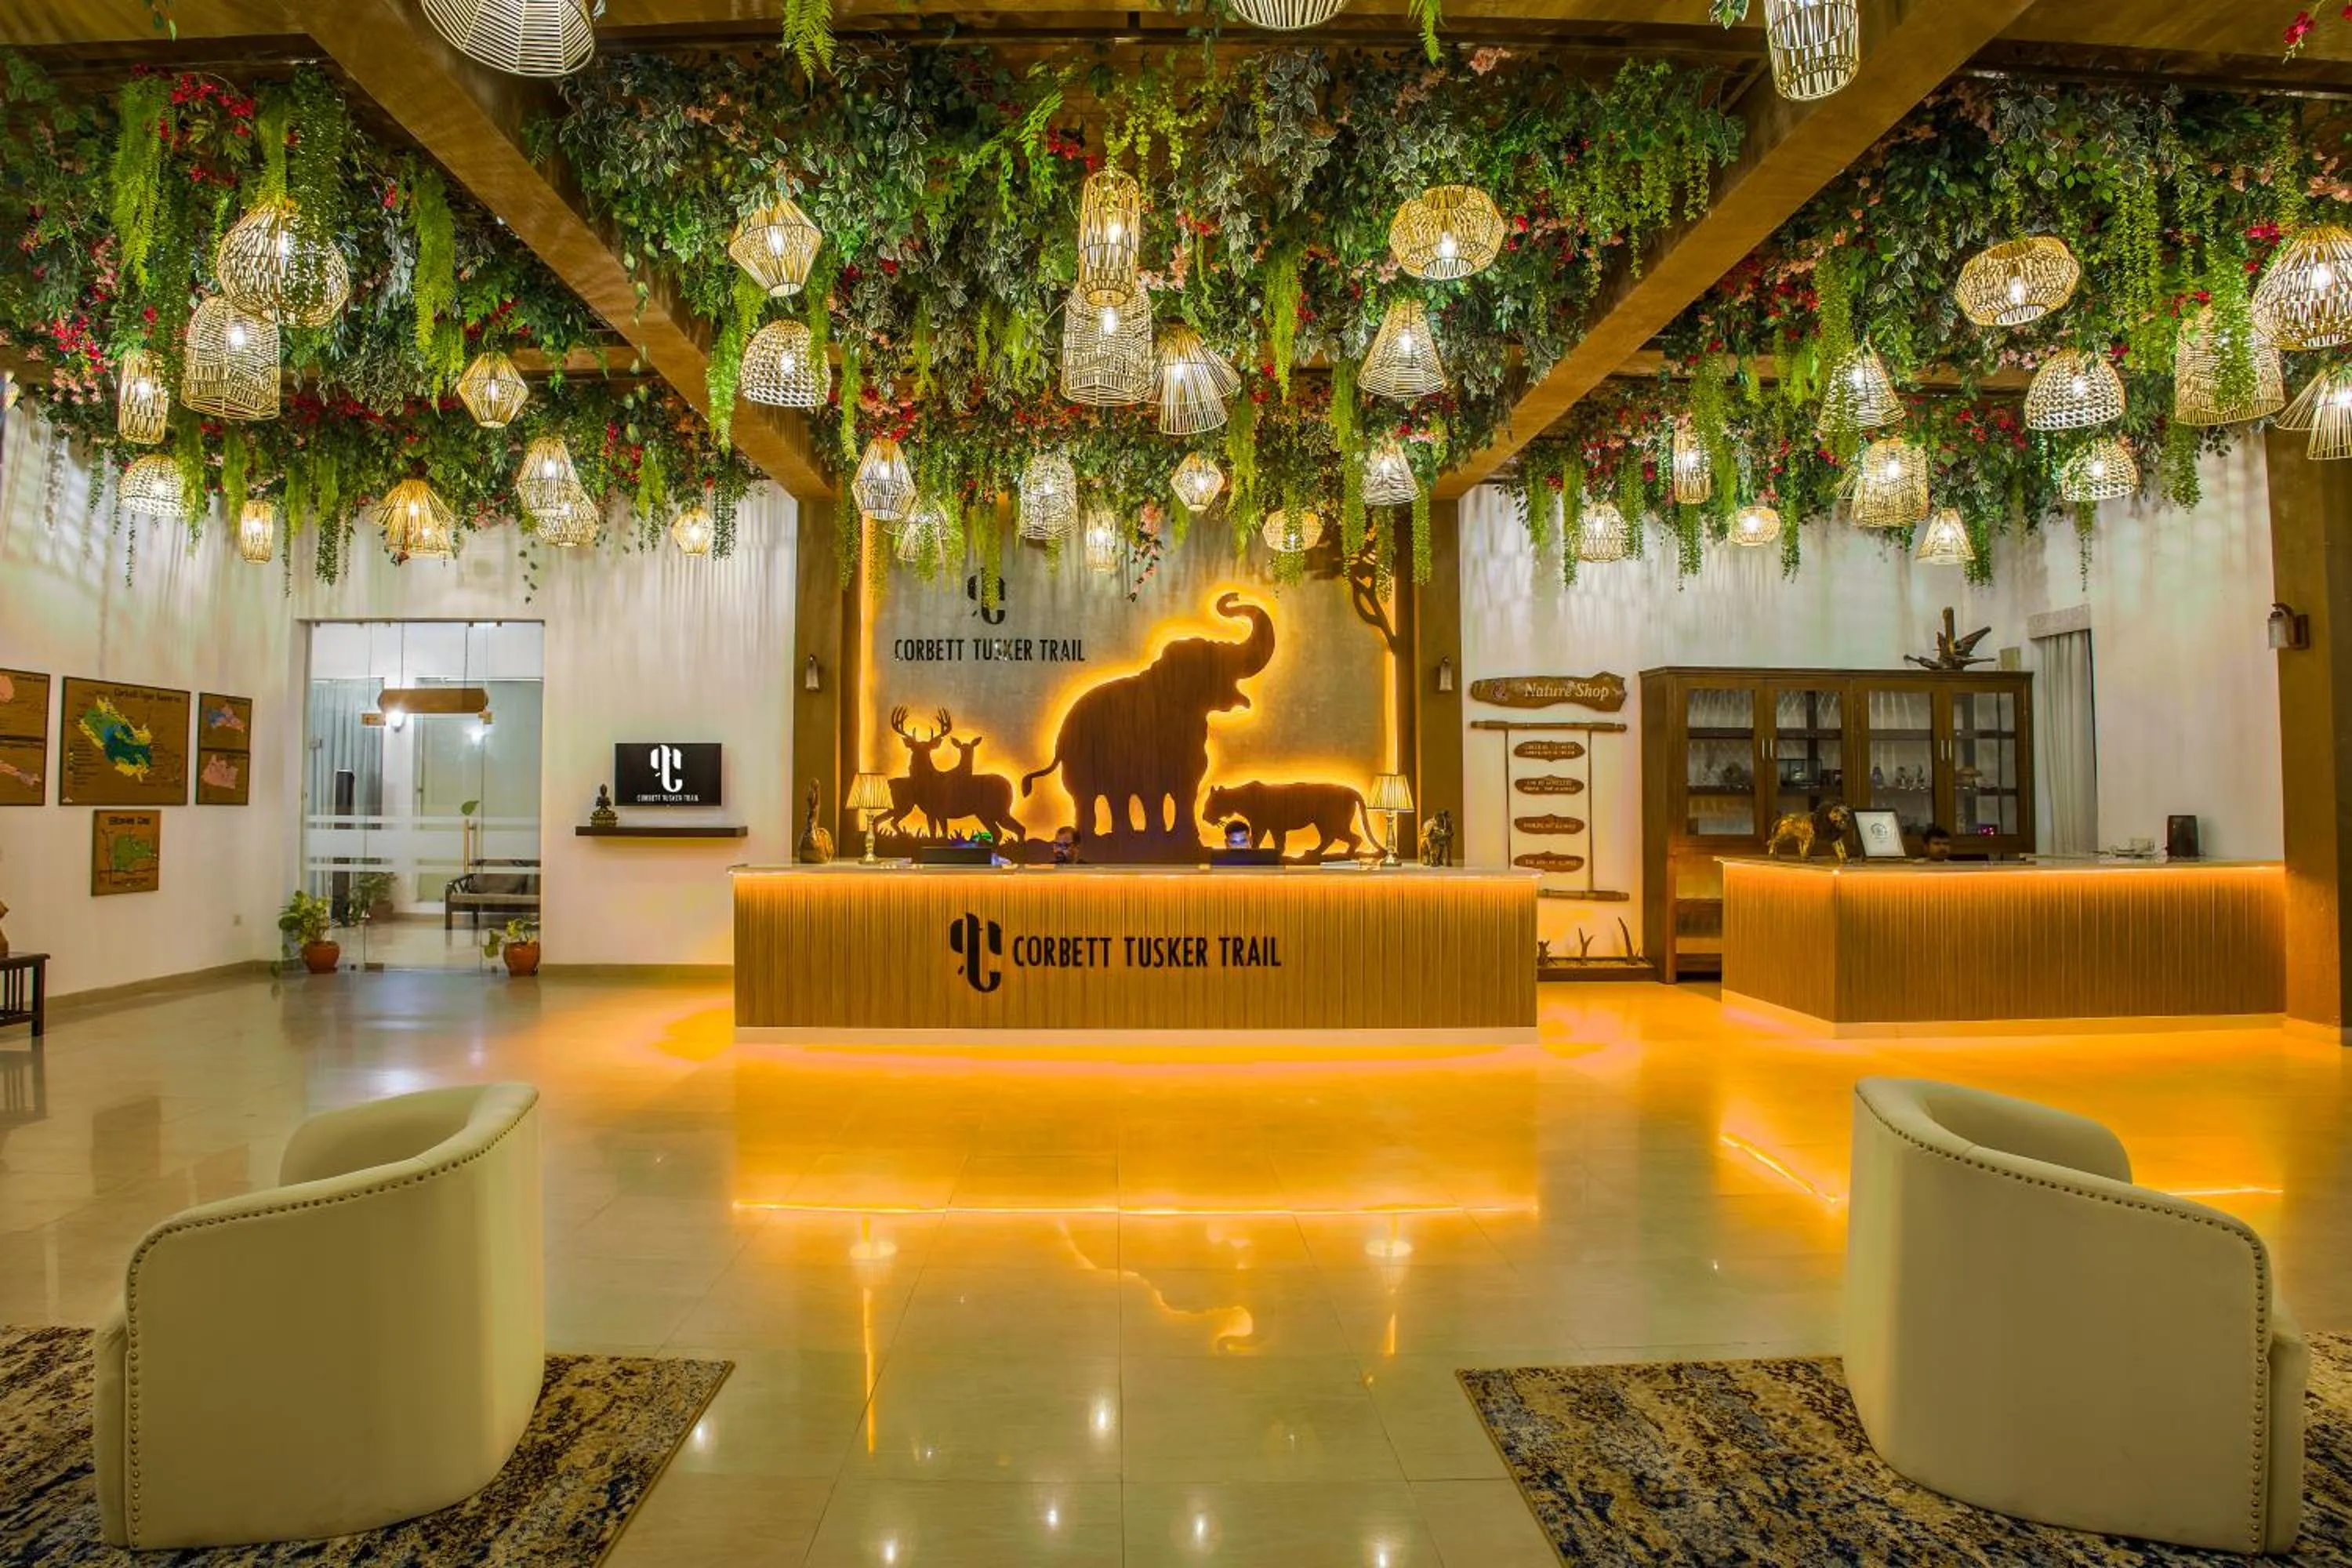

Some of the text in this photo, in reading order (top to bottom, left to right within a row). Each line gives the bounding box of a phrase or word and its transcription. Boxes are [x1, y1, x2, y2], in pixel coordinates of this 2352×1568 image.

[895, 638, 1085, 662] CORBETT TUSKER TRAIL
[1525, 682, 1610, 702] Nature Shop
[1012, 936, 1282, 968] CORBETT TUSKER TRAIL
